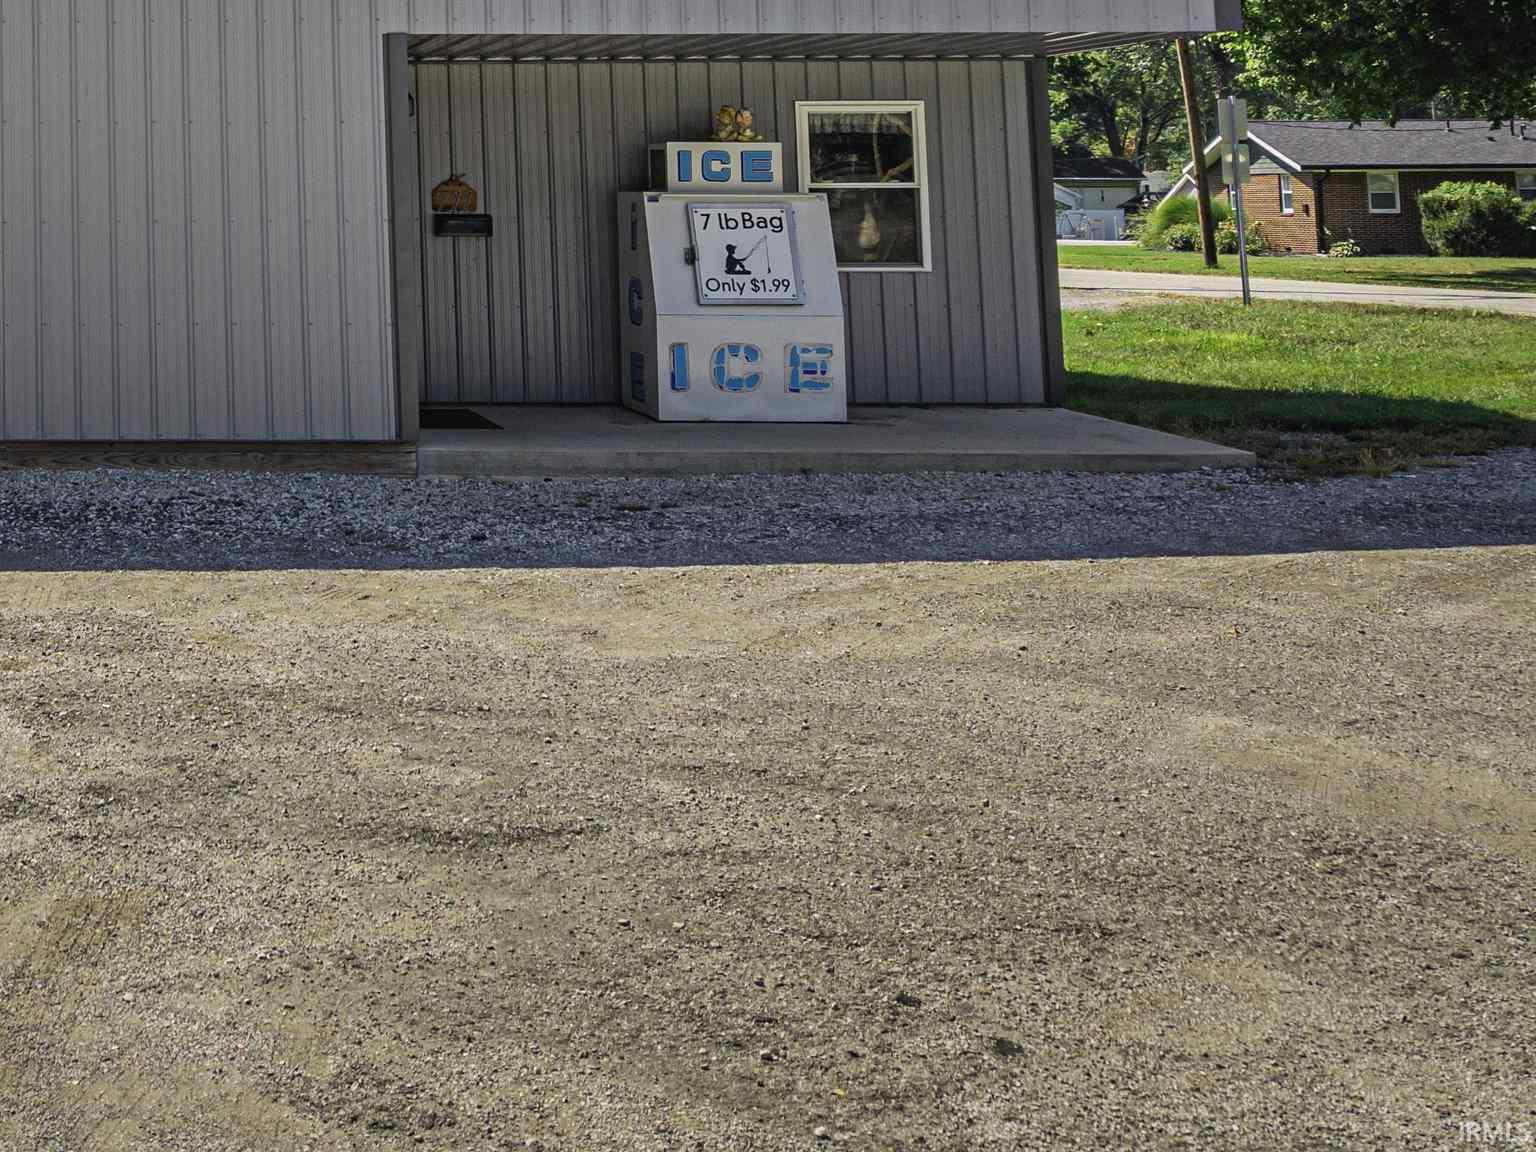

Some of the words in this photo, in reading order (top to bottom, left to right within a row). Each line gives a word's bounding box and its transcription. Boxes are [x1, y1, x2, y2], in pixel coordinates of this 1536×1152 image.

[677, 150, 774, 182] ICE
[700, 214, 711, 230] 7
[705, 278, 746, 296] Only
[750, 277, 790, 294] $1.99
[669, 342, 834, 393] ICE
